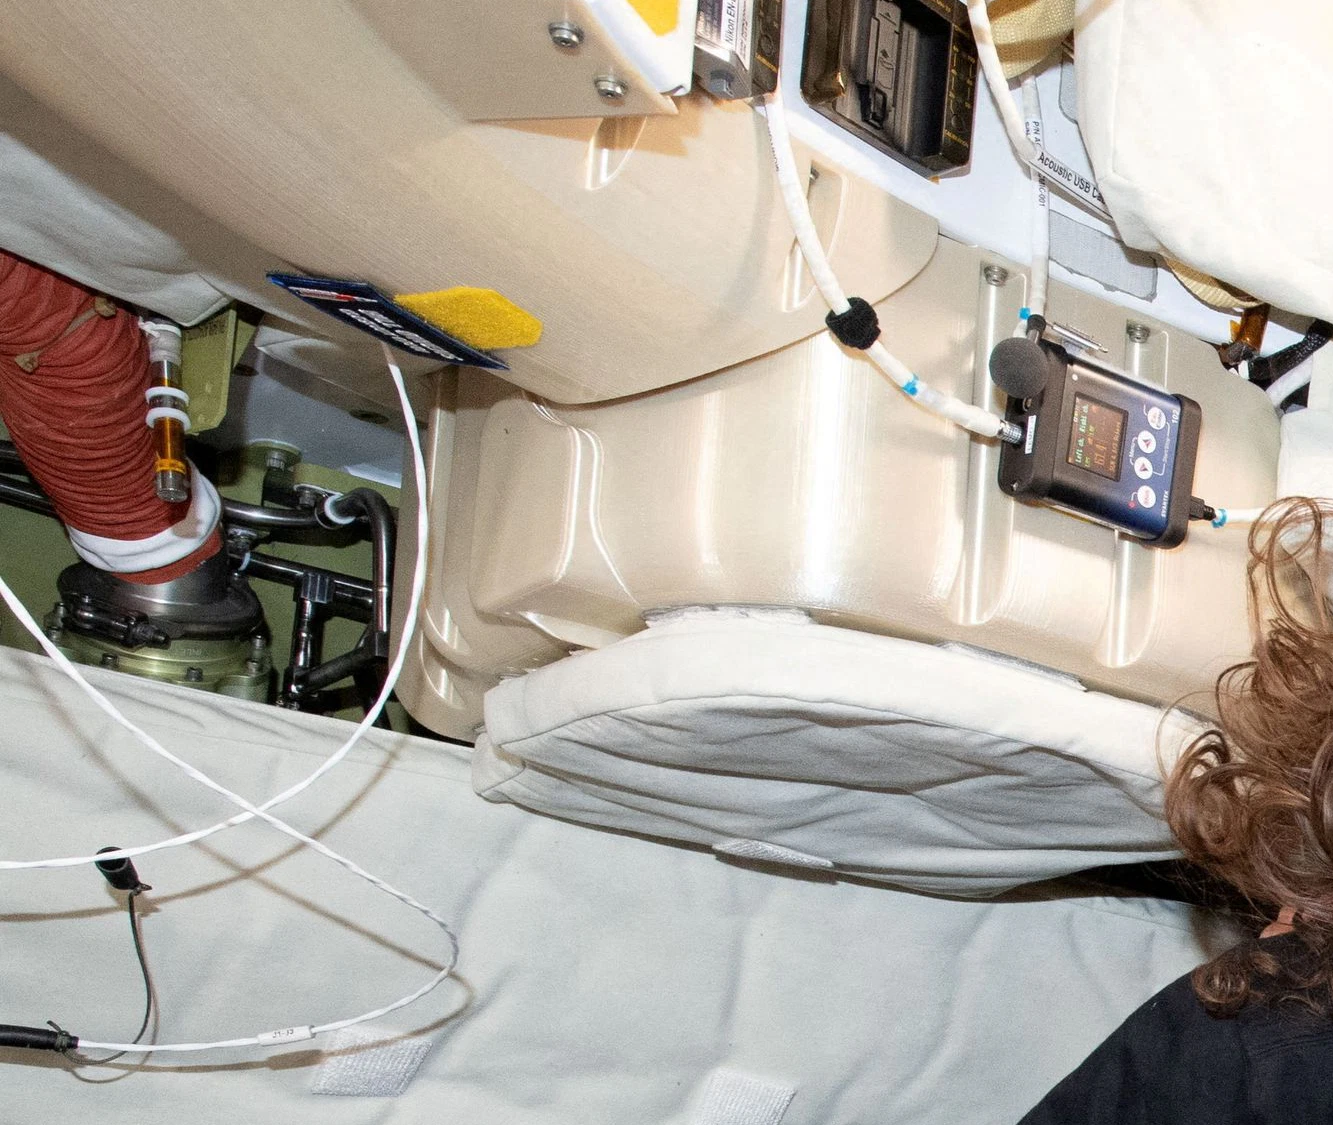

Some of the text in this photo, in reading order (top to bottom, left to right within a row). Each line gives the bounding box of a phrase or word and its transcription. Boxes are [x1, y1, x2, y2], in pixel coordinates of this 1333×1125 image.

[724, 20, 736, 45] Nikon
[1073, 174, 1091, 194] USB
[1172, 409, 1180, 425] 102
[1161, 489, 1170, 518] SVANTEK
